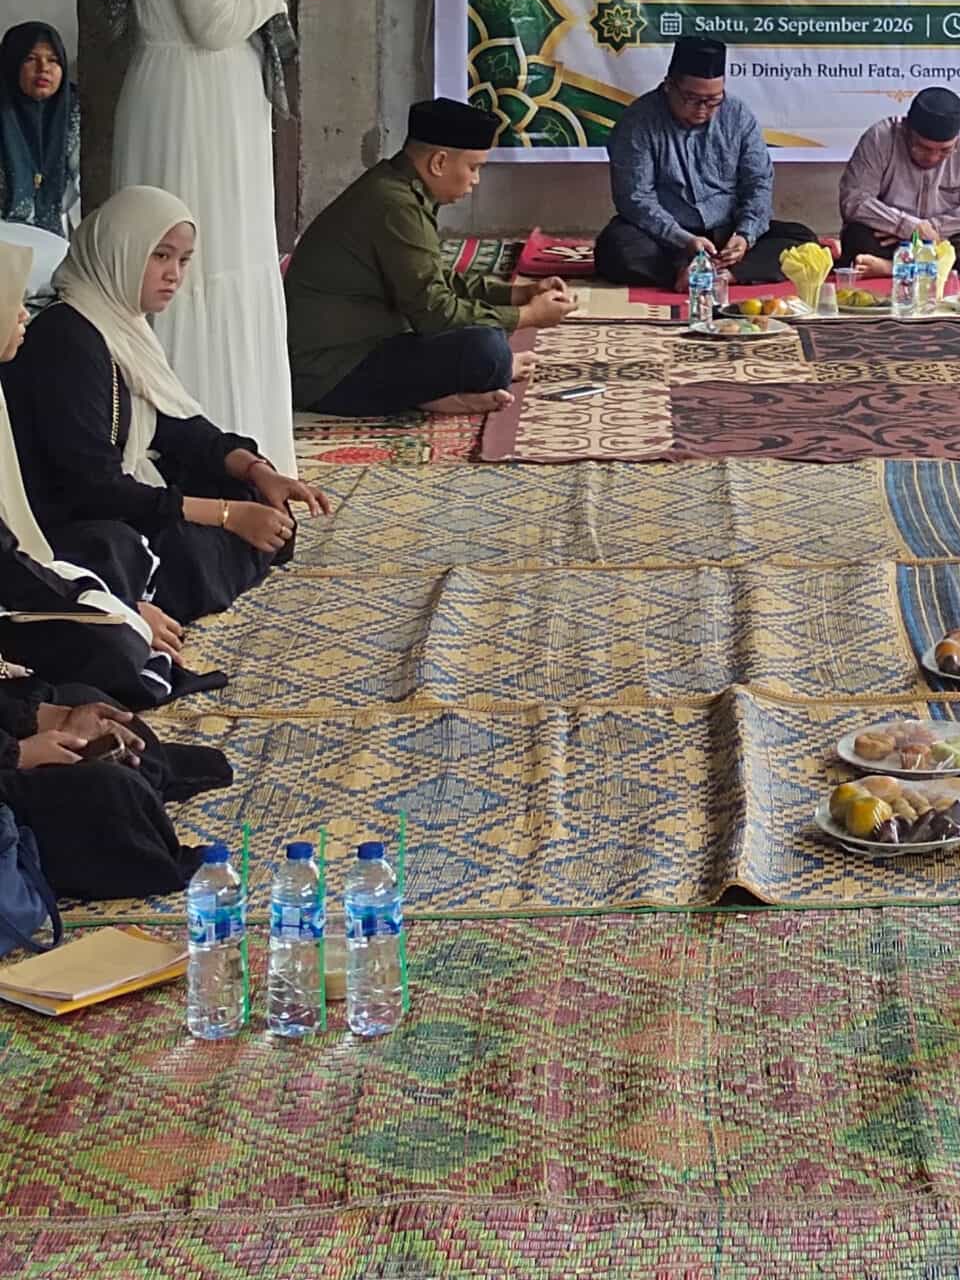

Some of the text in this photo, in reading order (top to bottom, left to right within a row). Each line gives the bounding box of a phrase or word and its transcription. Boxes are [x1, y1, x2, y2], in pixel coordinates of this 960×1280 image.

[695, 16, 749, 34] Sabtu,
[753, 18, 774, 33] 26
[777, 17, 869, 37] September
[873, 18, 913, 33] 2026
[729, 62, 747, 77] Di
[752, 63, 812, 81] Diniyah
[817, 63, 863, 78] Ruhul
[868, 63, 905, 80] Fata,
